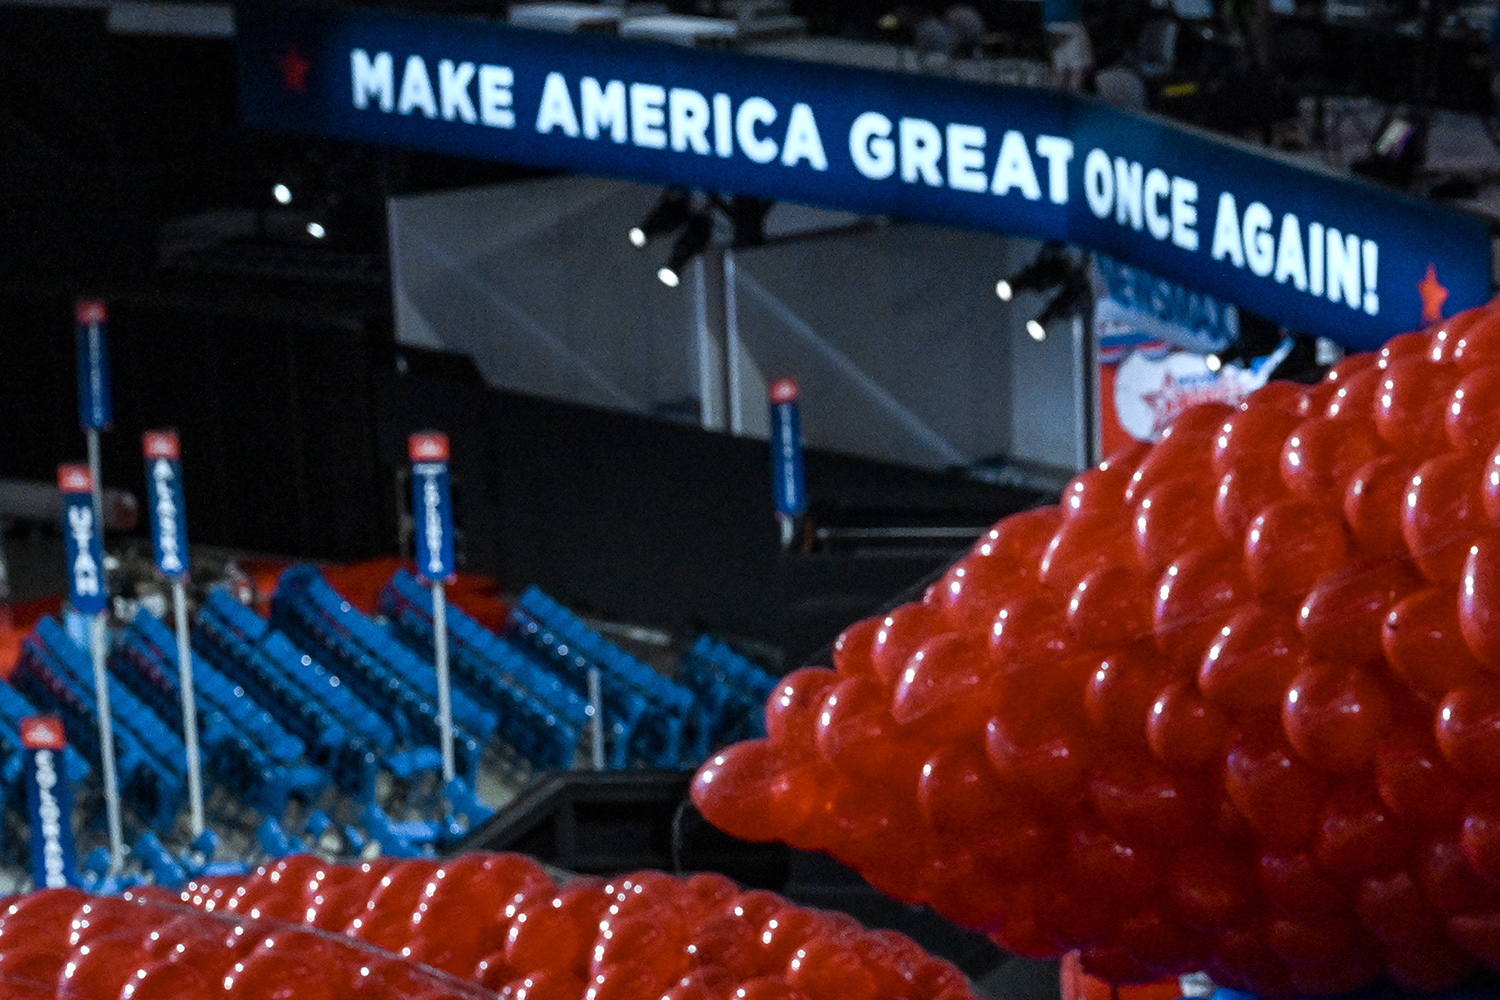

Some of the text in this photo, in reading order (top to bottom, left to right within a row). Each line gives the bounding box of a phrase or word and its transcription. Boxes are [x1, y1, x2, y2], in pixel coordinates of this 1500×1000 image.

[351, 49, 1380, 317] MAKE AMERICA GREAT ONCE AGAIN!
[68, 504, 99, 597] UTAH
